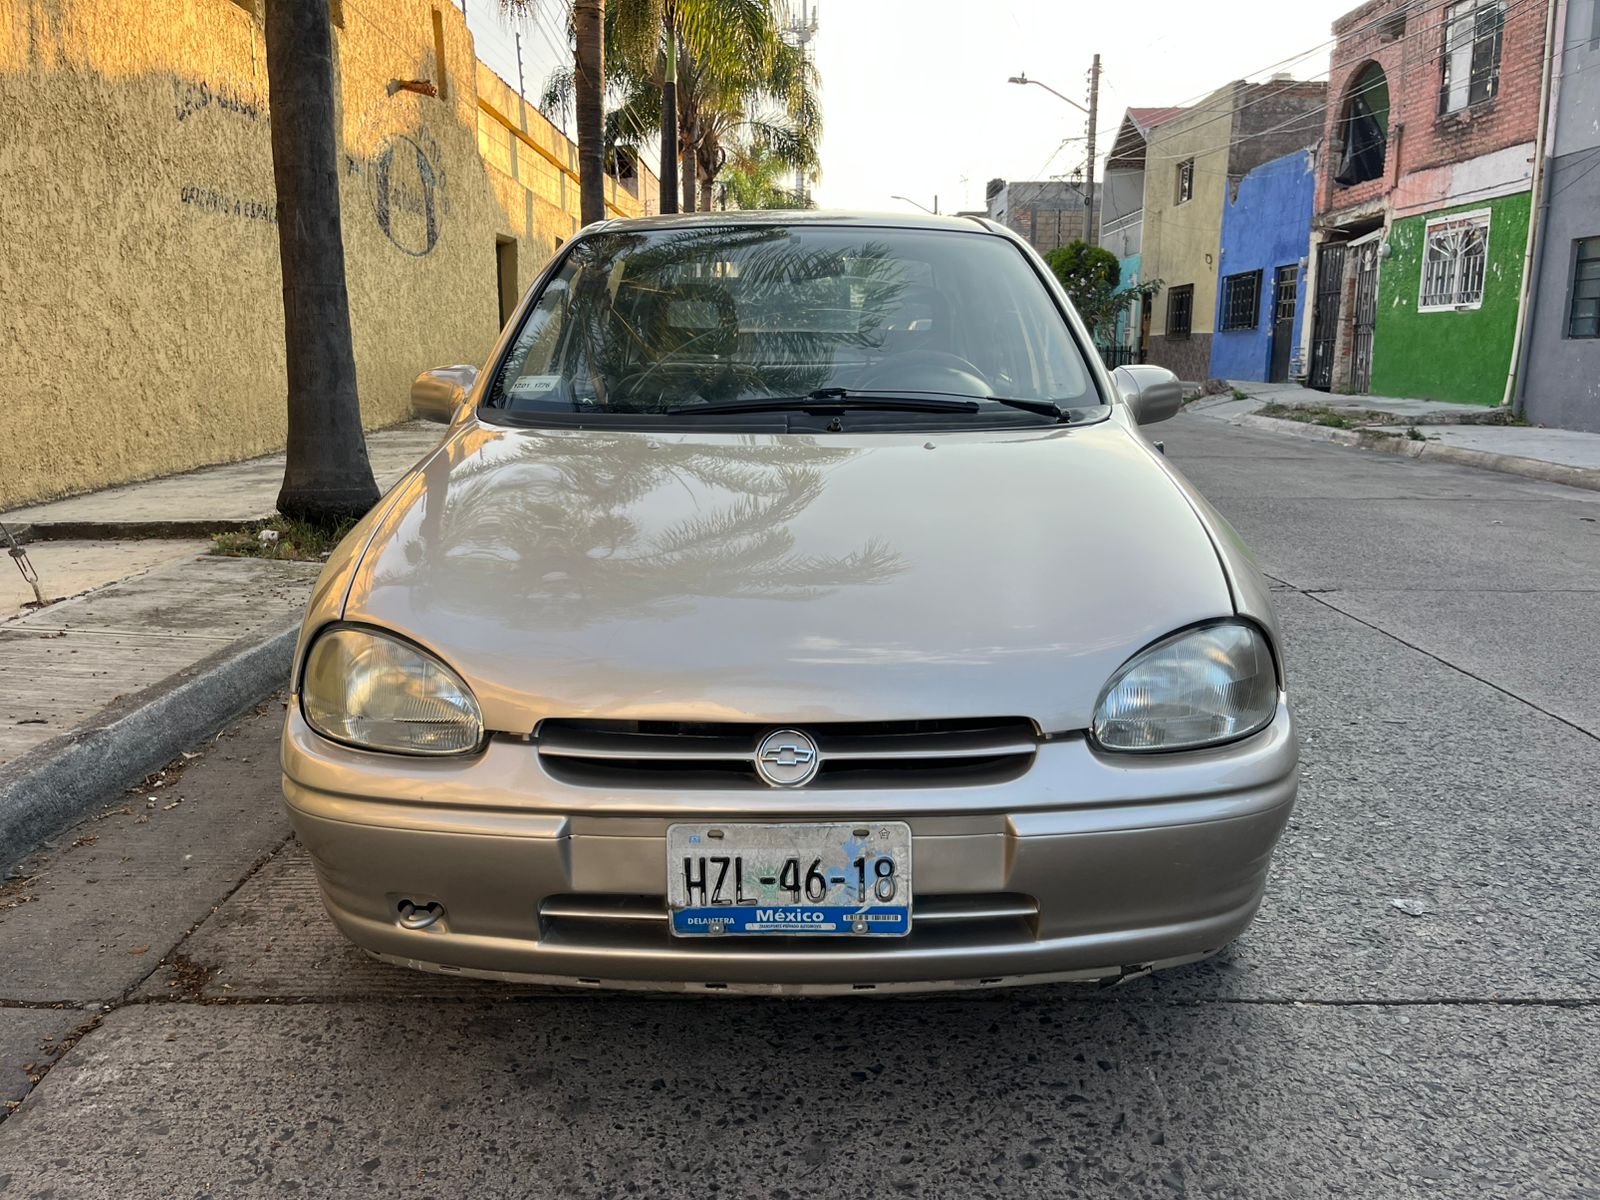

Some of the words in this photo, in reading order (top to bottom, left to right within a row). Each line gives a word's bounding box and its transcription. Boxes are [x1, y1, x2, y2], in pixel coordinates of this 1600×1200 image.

[683, 857, 896, 905] HZL-46-18
[687, 917, 735, 925] DELANTERA
[756, 909, 824, 922] México
